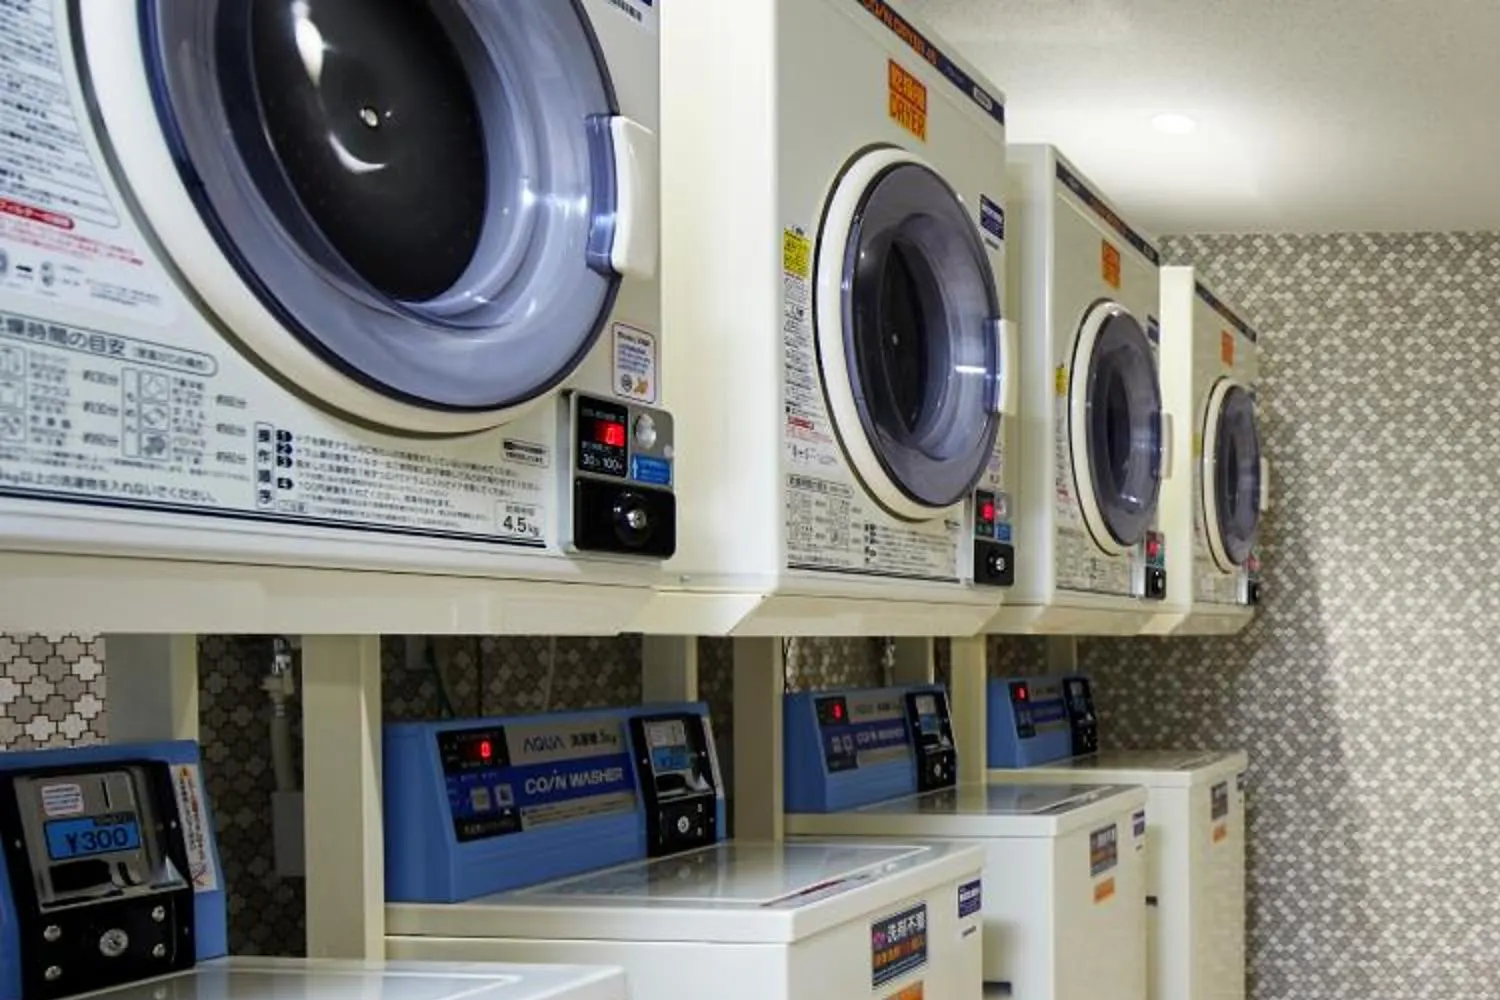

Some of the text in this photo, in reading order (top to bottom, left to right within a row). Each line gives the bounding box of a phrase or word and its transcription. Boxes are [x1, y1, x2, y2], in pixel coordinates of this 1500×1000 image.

[0, 317, 127, 356] 燥時間の目安
[569, 766, 624, 788] WASHER
[64, 826, 130, 855] ¥300
